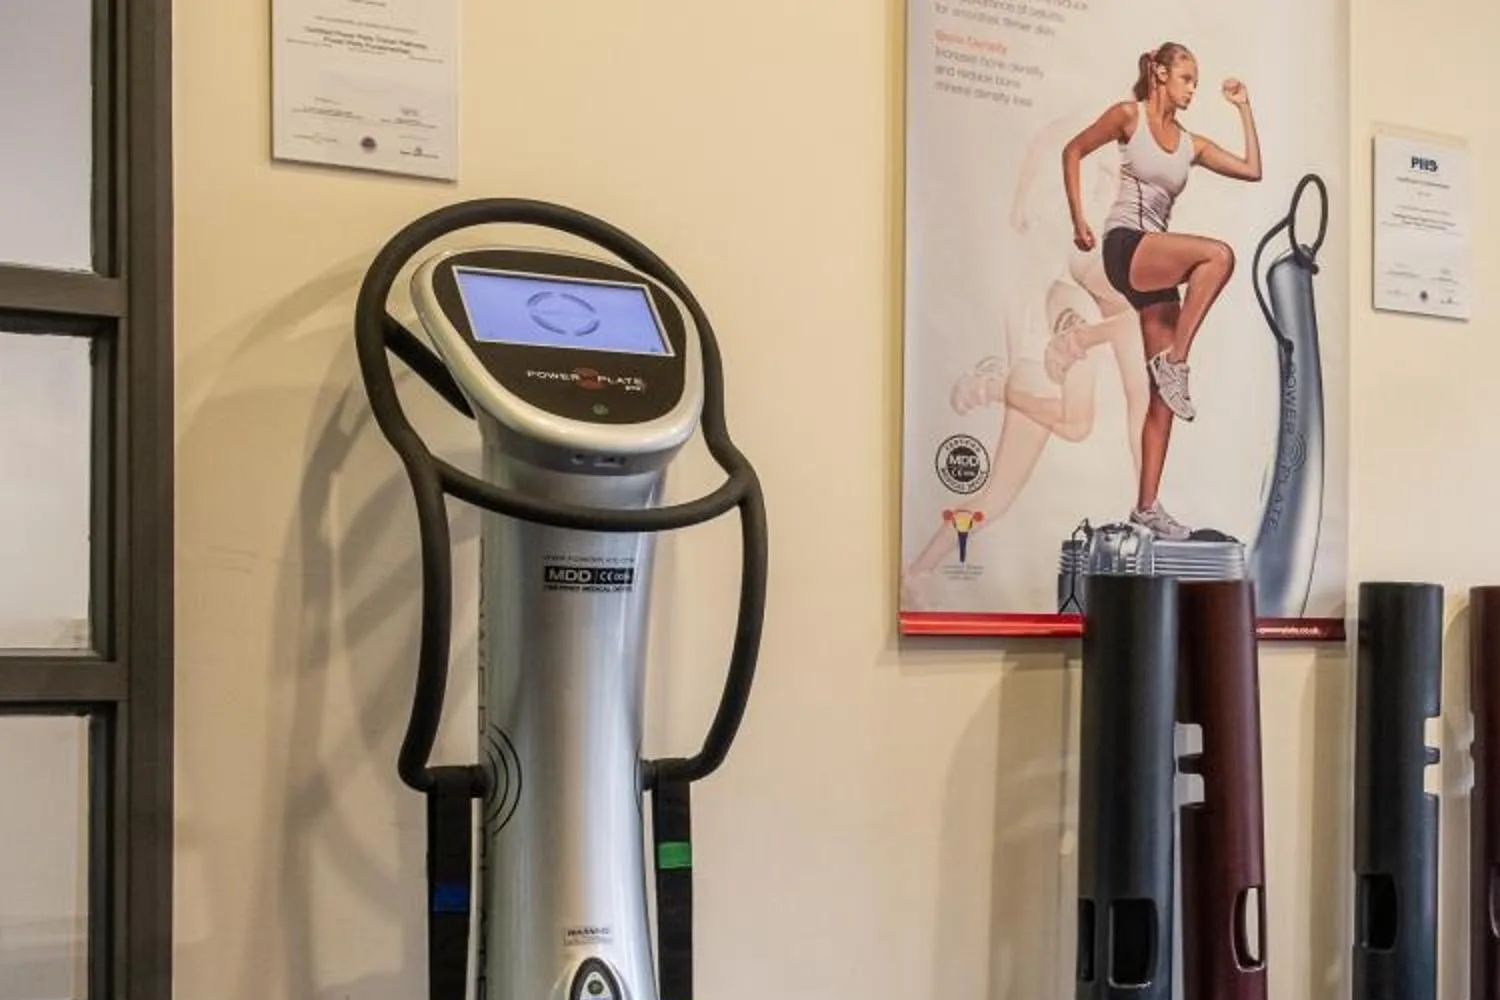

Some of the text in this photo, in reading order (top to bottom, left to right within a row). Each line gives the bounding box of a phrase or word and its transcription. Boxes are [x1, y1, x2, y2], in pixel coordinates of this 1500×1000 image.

[526, 370, 644, 385] POWER PLATE
[549, 568, 592, 582] MDD
